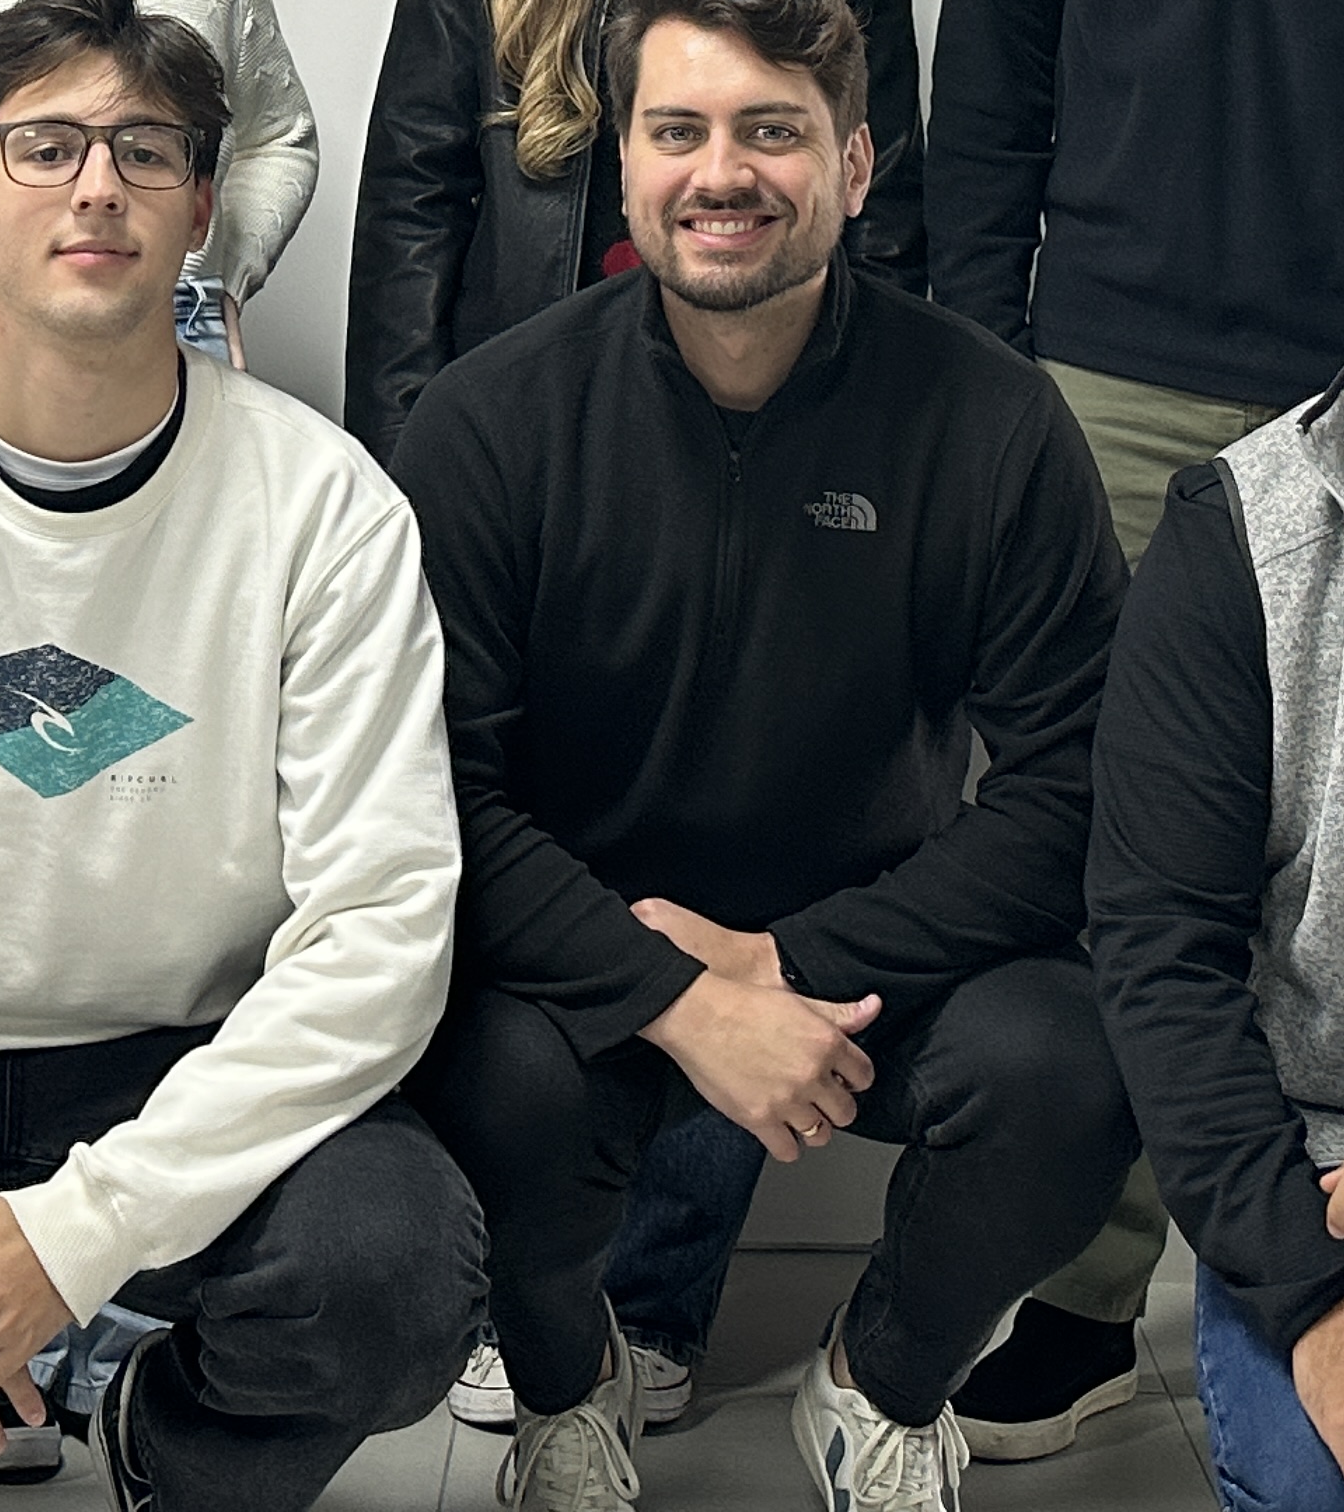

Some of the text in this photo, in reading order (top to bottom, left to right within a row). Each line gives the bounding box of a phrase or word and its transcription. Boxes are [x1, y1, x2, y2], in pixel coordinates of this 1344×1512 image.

[823, 491, 851, 505] THE
[802, 503, 851, 518] NORTH
[815, 516, 850, 528] FACE
